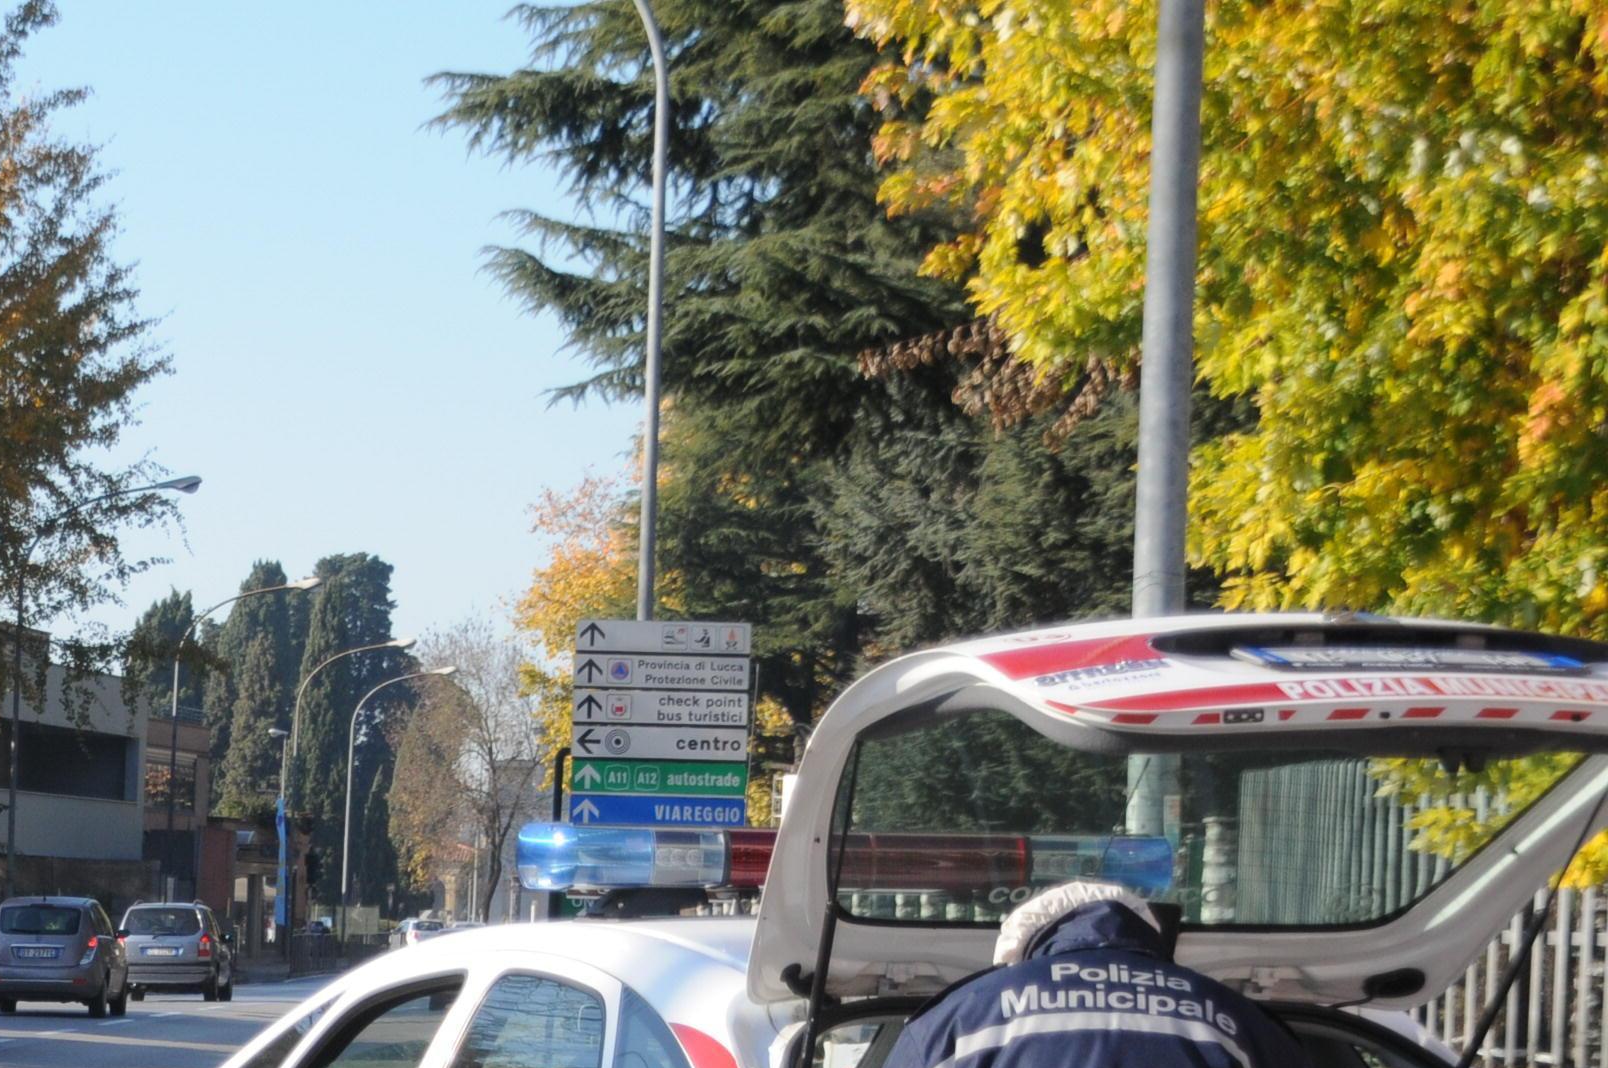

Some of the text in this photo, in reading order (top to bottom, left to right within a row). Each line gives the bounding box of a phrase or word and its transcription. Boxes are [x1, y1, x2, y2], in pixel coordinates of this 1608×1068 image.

[638, 659, 744, 672] Provincia di Lucca
[644, 674, 743, 686] Protezione Civile
[1277, 677, 1432, 700] POLIZIA
[658, 695, 743, 709] check point
[657, 710, 743, 723] bus turistici
[676, 736, 741, 751] centro
[607, 771, 741, 788] A11 A12 autostrade
[654, 804, 741, 823] VIAREGGIO
[1050, 962, 1193, 993] Polizia
[999, 983, 1238, 1036] Municipale
